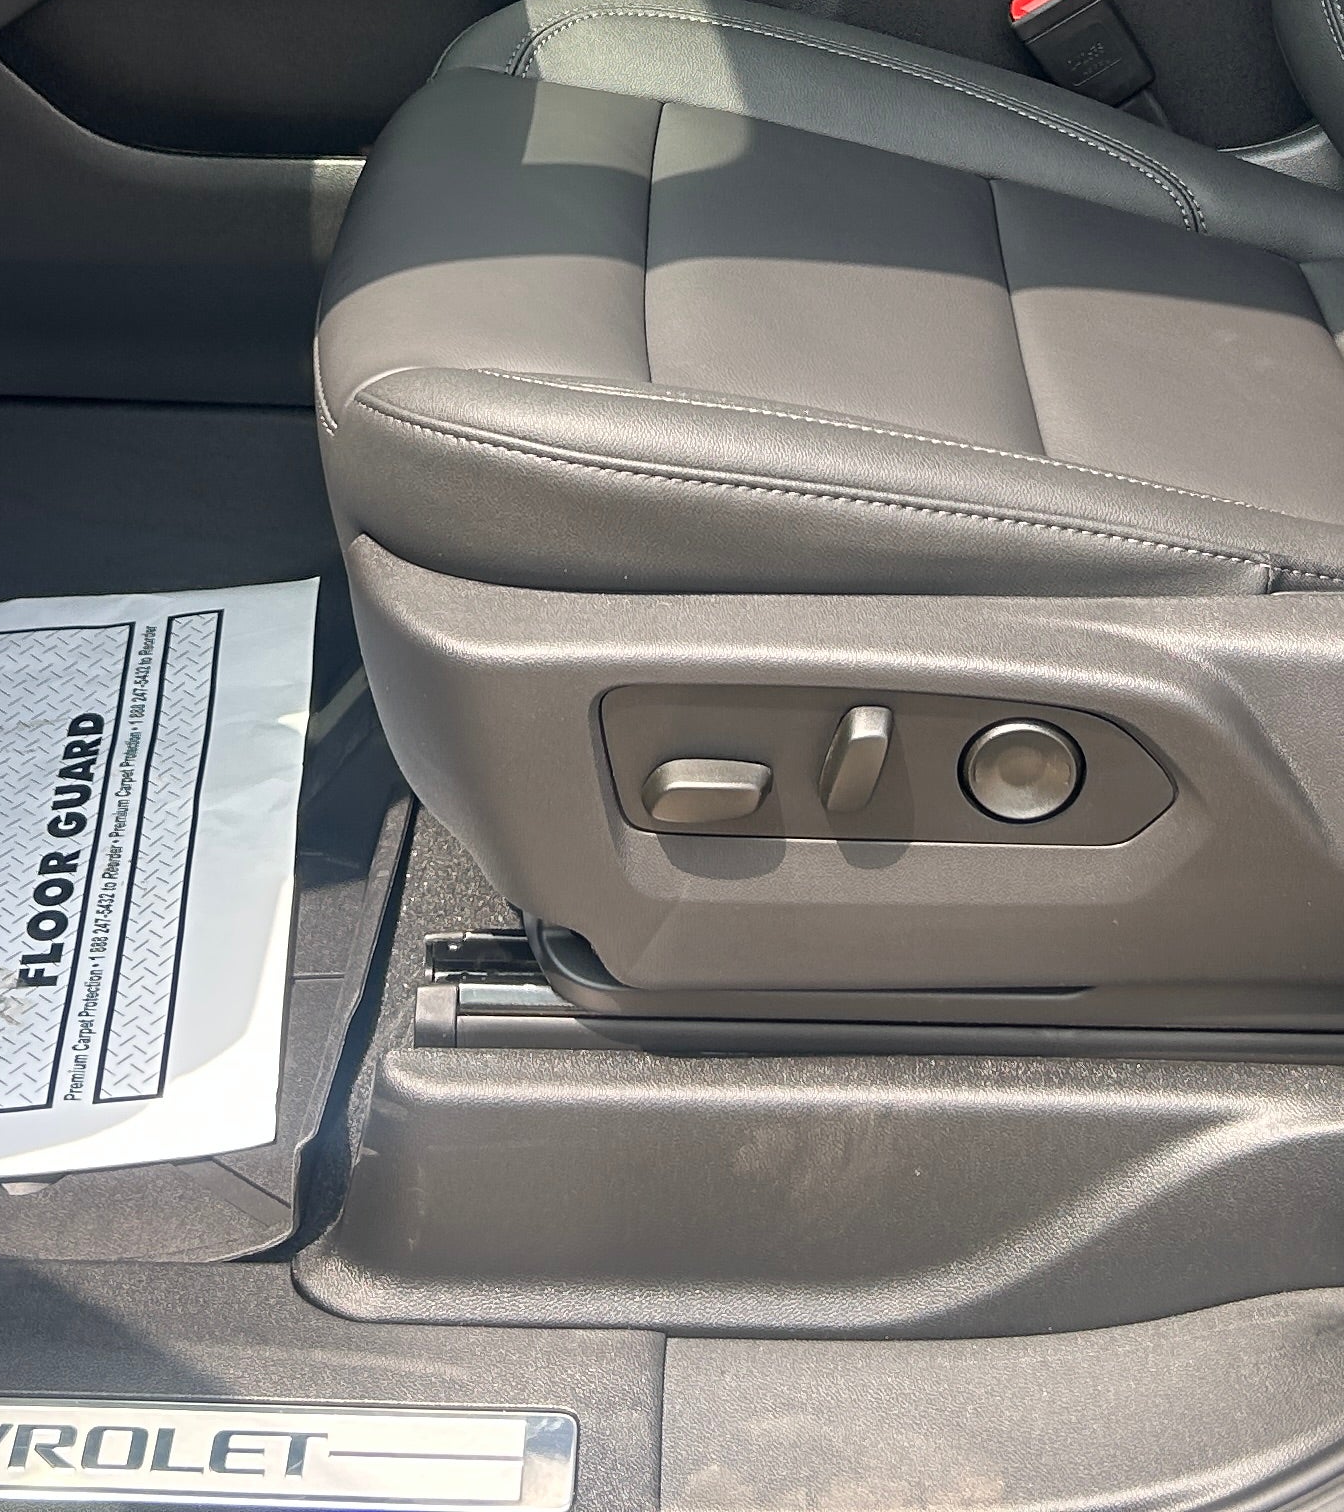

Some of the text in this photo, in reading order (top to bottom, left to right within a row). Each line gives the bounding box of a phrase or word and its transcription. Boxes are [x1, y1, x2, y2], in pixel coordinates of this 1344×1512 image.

[138, 625, 157, 654] Reorder
[119, 732, 141, 766] Protection
[114, 769, 137, 796] Carpet
[108, 799, 130, 837] Premium
[17, 713, 105, 988] FLOOR GUARD
[101, 846, 123, 878] Reorder
[99, 881, 116, 890] to
[91, 892, 115, 933] 247-5432
[78, 969, 103, 1016] Protection
[72, 1019, 98, 1050] Carpet
[63, 1054, 88, 1100] Premium
